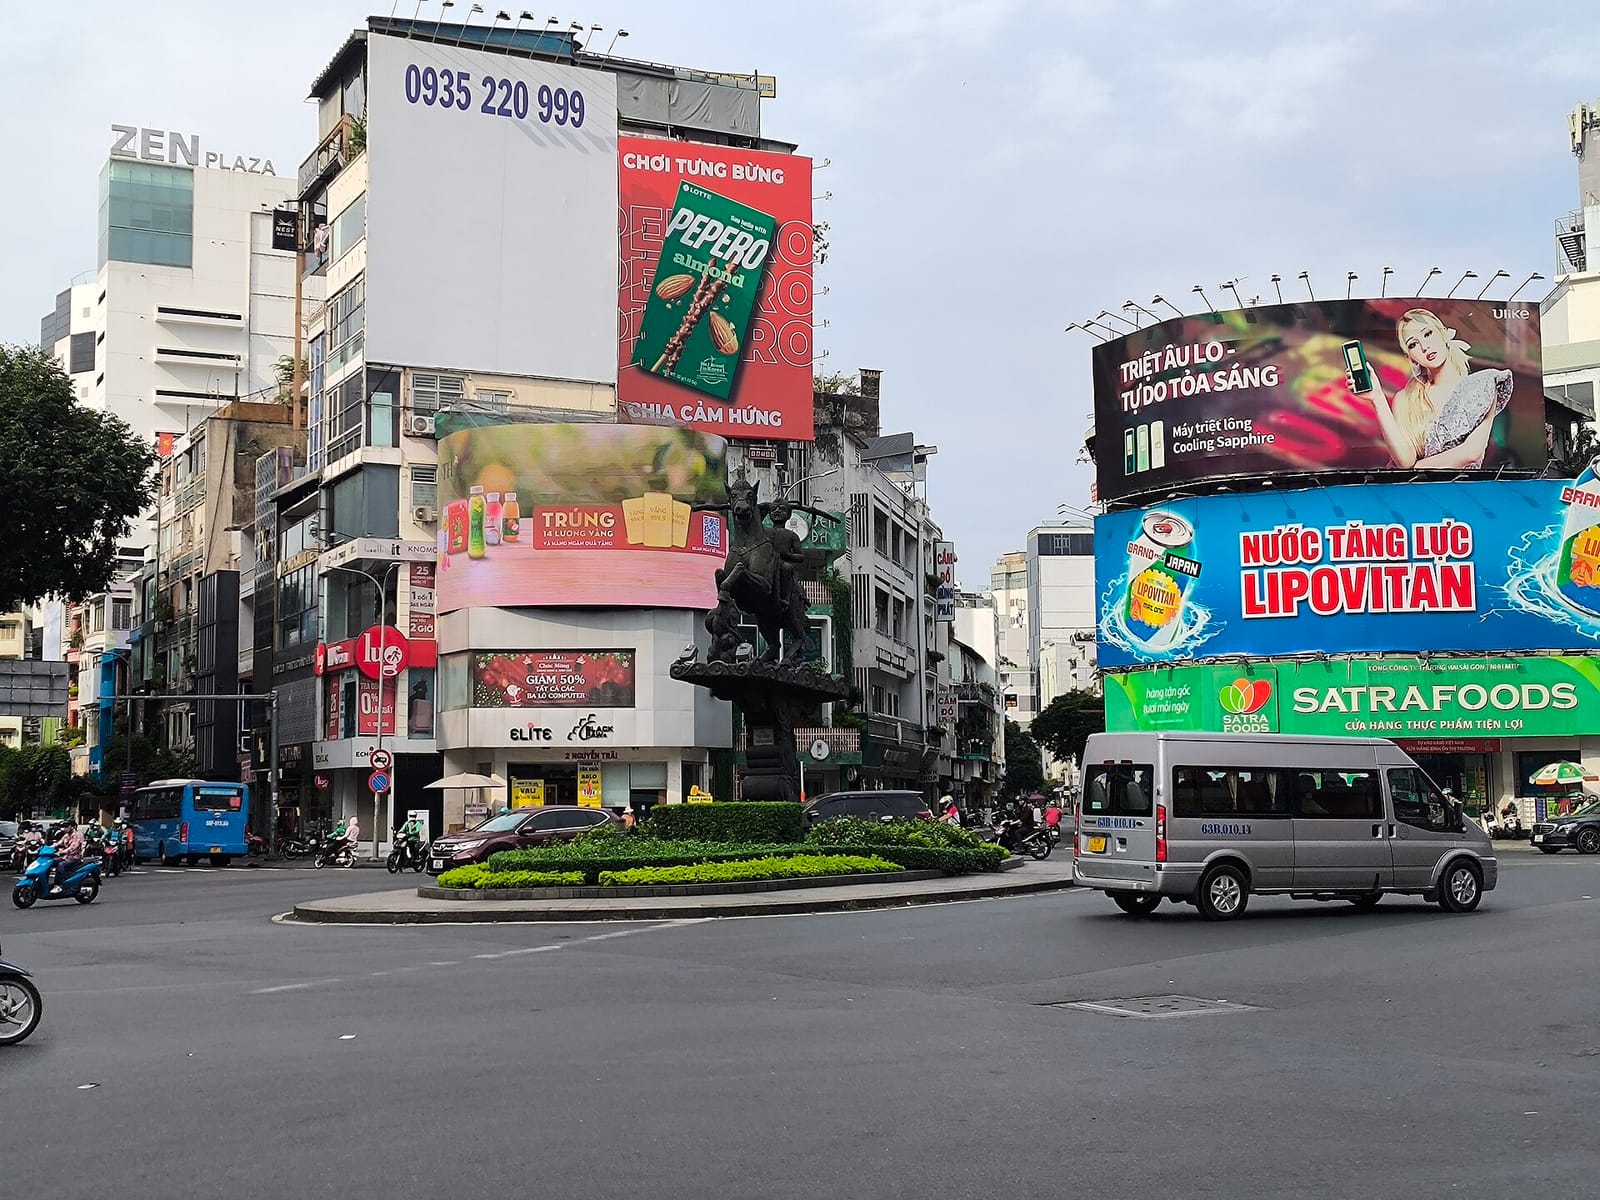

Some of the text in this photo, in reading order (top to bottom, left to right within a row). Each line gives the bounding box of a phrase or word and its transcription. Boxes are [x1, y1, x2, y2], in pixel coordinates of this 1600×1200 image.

[405, 64, 585, 128] 0935 220 999
[110, 124, 276, 176] ZEN PLAZA
[623, 152, 785, 184] CHƠI TƯNG BỪNG
[690, 187, 712, 200] LOTTE
[665, 207, 770, 270] PEPERO
[673, 253, 745, 288] almond
[1492, 308, 1530, 320] Ulike
[1120, 350, 1163, 384] TRIỆT
[1164, 343, 1190, 368] ÂU
[1193, 341, 1223, 364] LO
[1121, 361, 1279, 415] TỰ DO TỎA SÁNG
[627, 400, 782, 427] CHIA CẢM HỨNG
[1172, 418, 1252, 439] Máy triệt lông
[1173, 433, 1275, 454] Cooling Sapphire
[541, 507, 615, 528] TRÚNG
[588, 528, 614, 537] VÀNG
[1242, 521, 1469, 564] NƯỚC TĂNG LỰC
[1128, 542, 1154, 560] BRAND
[1167, 555, 1199, 576] JAPAN
[416, 566, 429, 575] 25
[411, 591, 416, 600] 1
[428, 591, 433, 600] 1
[1137, 582, 1175, 606] LIPOVITAN
[1243, 565, 1473, 615] LIPOVITAN
[410, 623, 417, 632] 2
[364, 633, 403, 676] lug
[526, 673, 586, 685] GIẢM 50%
[1146, 687, 1164, 700] hàng
[1177, 684, 1191, 699] gốc
[1292, 682, 1579, 713] SATRAFOODS
[1171, 700, 1190, 714] ngày
[1223, 714, 1268, 723] SATRA
[1223, 723, 1269, 733] FOODS
[1345, 716, 1524, 731] CỬA HÀNG THỰC PHẨM TIỆN LỢI
[1201, 823, 1252, 835] 63B.010.14
